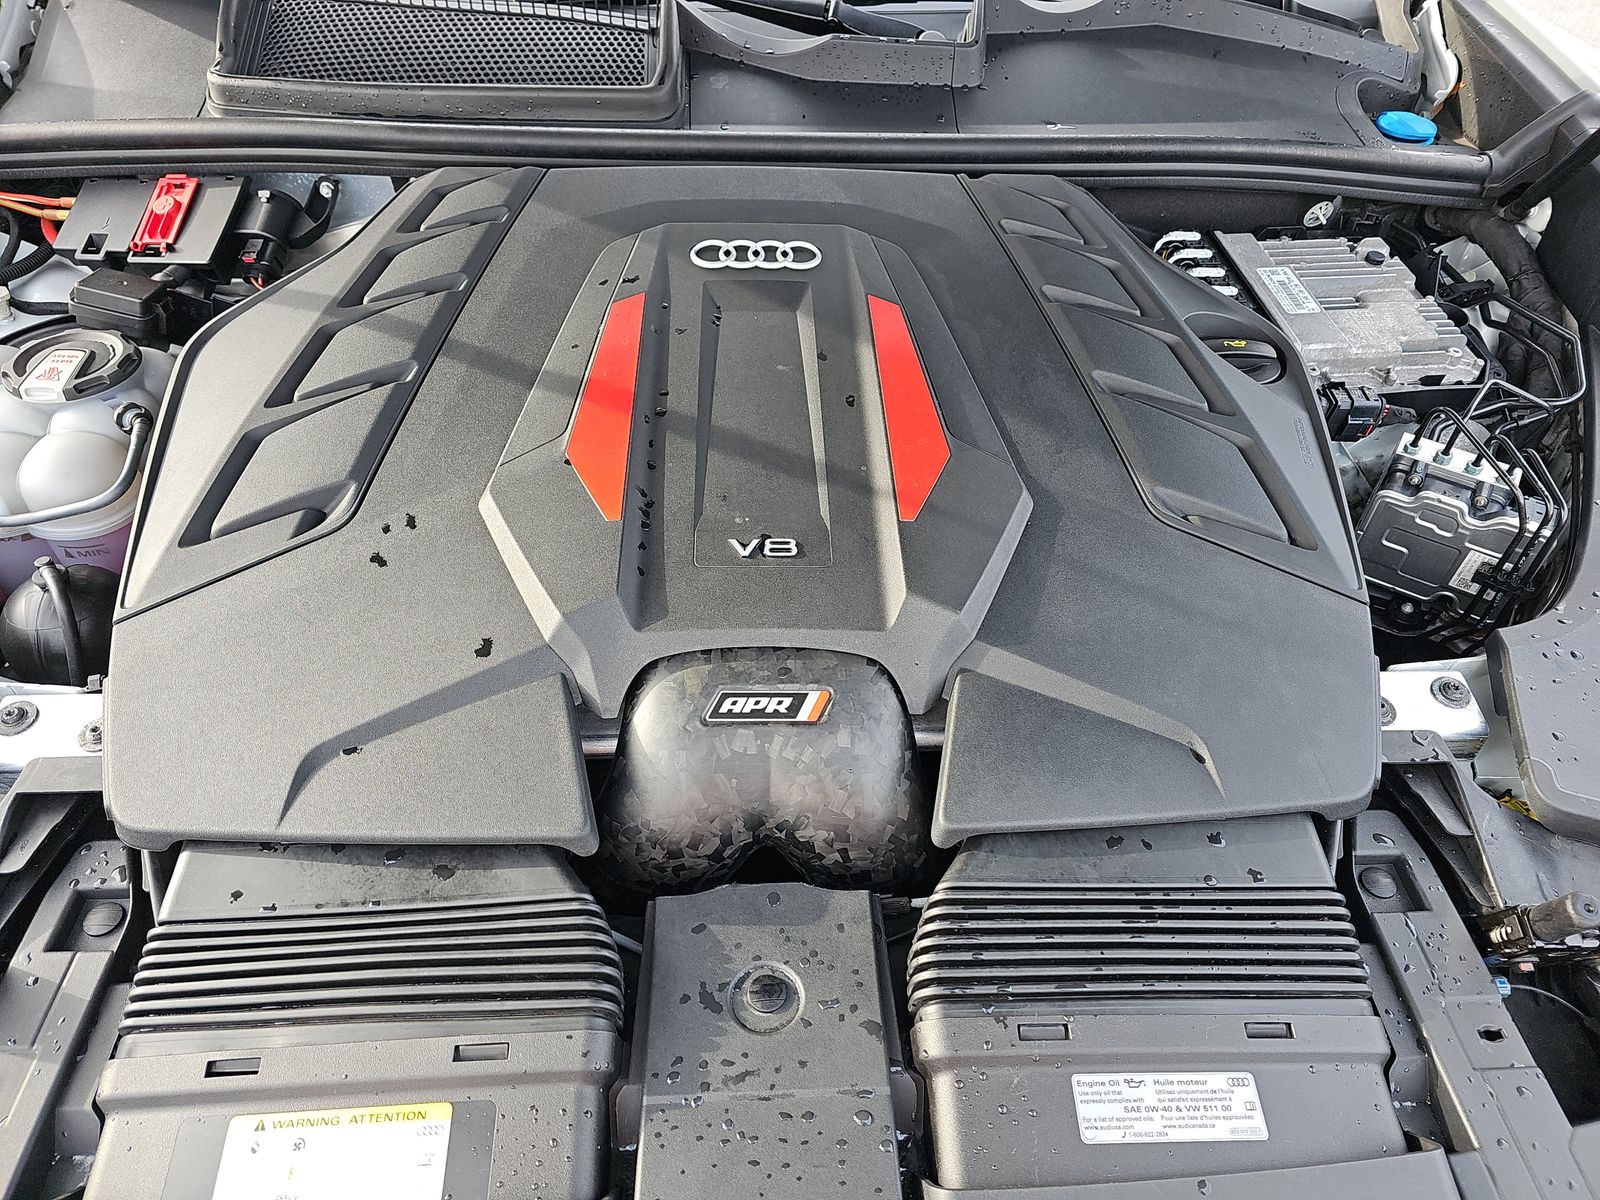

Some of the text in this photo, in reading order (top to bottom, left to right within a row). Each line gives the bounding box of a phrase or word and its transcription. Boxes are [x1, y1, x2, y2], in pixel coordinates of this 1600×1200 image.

[76, 548, 111, 558] MIN
[727, 538, 798, 558] V8
[718, 696, 794, 714] APR
[1076, 1080, 1106, 1088] Engine
[1144, 1105, 1173, 1113] 0W-40
[272, 1110, 427, 1130] WARNING ATTENTION
